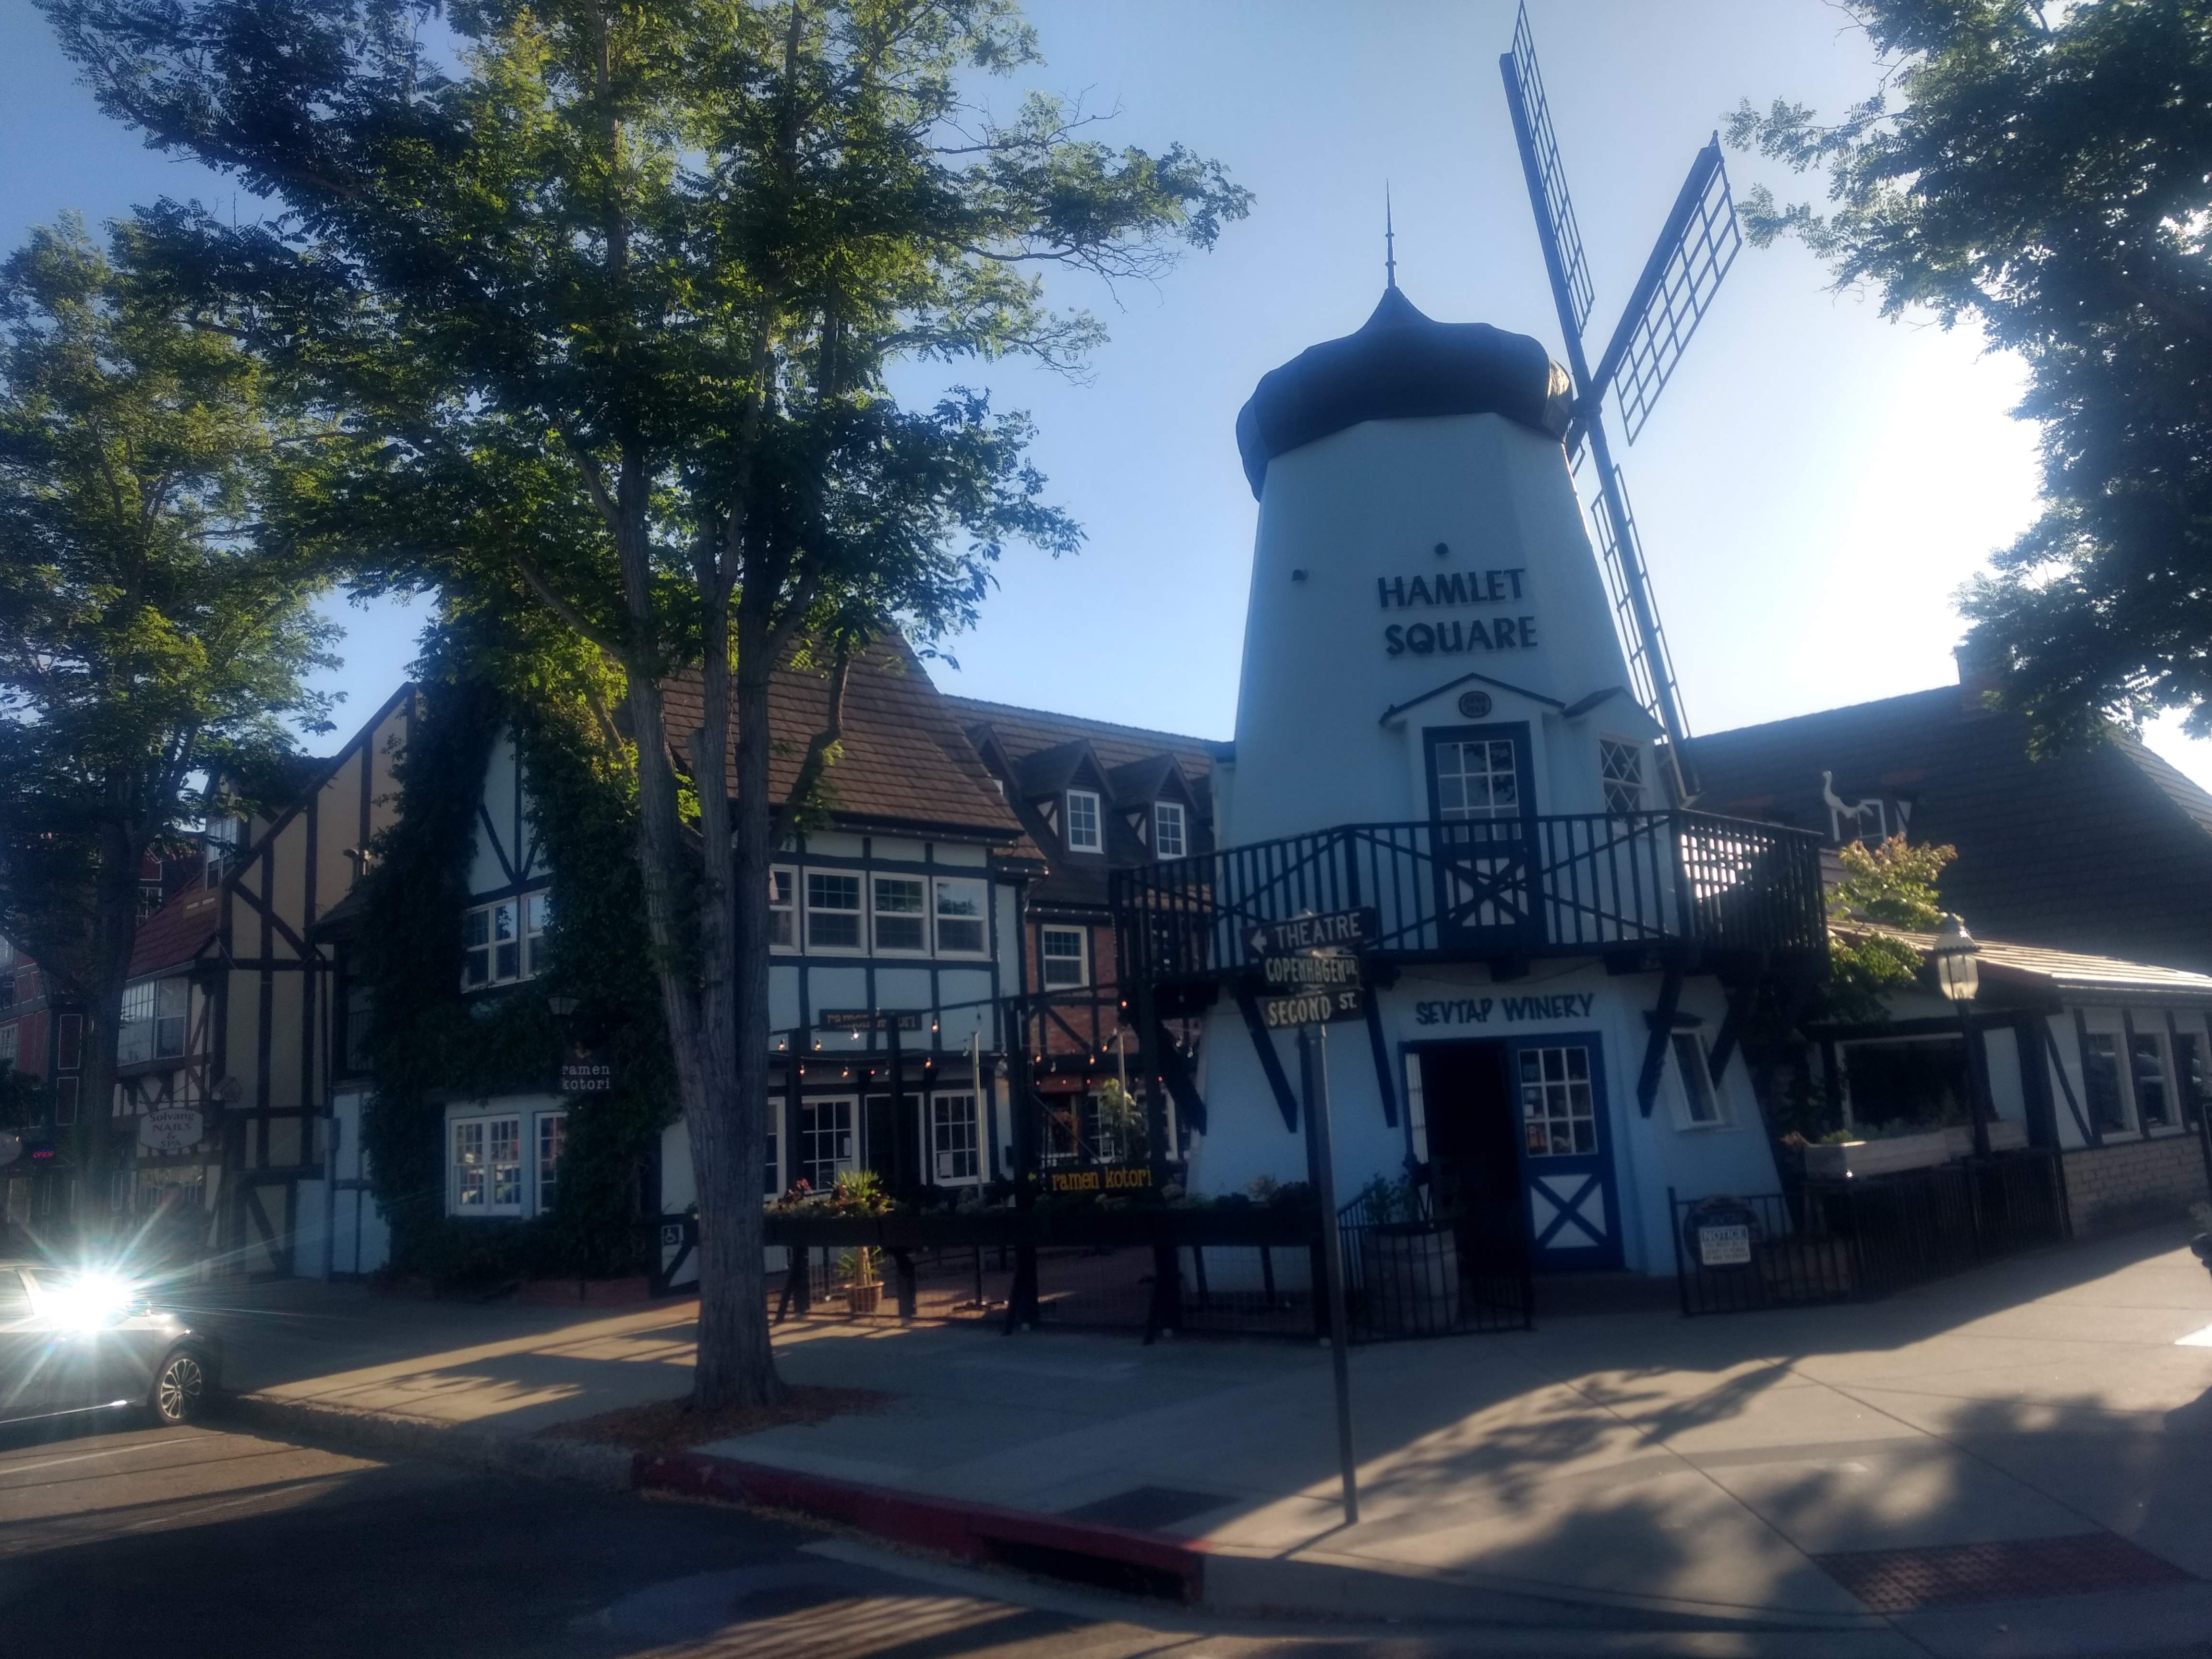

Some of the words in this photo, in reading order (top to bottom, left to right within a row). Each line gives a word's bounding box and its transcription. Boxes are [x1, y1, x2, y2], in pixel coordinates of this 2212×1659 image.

[1378, 568, 1526, 608] HAMLET
[1385, 616, 1538, 655] SQUARE
[1275, 913, 1362, 949] THEATRE
[1265, 957, 1346, 983] COPENHAGEN
[1268, 996, 1331, 1026] SECOND
[1339, 992, 1357, 1010] ST.
[1415, 998, 1493, 1025] SEVTAP
[1502, 993, 1594, 1022] WINERY
[562, 1065, 610, 1075] ramen
[562, 1078, 610, 1090] kotori
[149, 1113, 194, 1122] Solvang
[153, 1123, 192, 1132] NAILS
[160, 1140, 181, 1148] SPA
[1052, 1171, 1099, 1191] ramen
[1105, 1165, 1152, 1188] kotori
[1704, 1230, 1745, 1240] NOTICE
